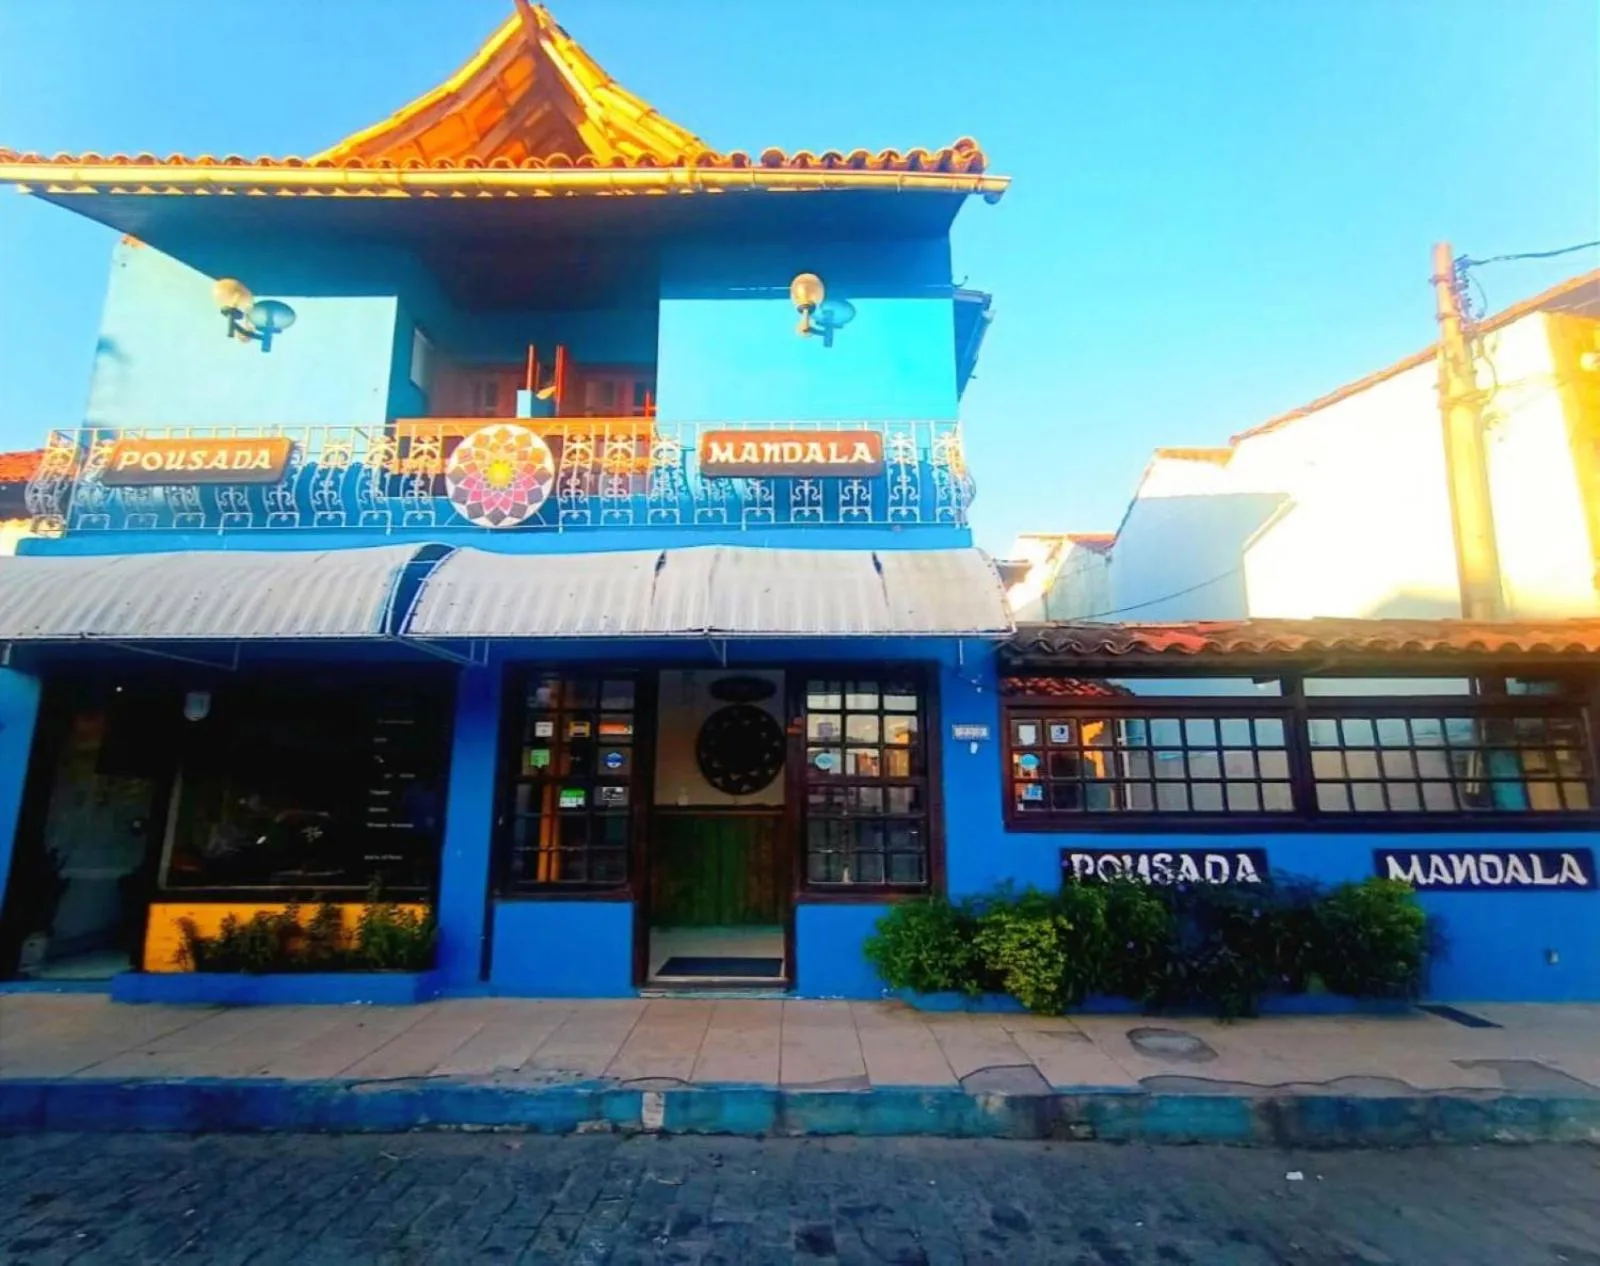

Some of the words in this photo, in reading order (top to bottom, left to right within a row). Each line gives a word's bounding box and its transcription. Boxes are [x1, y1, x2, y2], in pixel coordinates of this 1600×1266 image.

[116, 449, 272, 471] POUSADA
[707, 441, 877, 464] MANDALA
[1071, 853, 1262, 885] POUSADA
[1386, 853, 1588, 885] MANDALA
